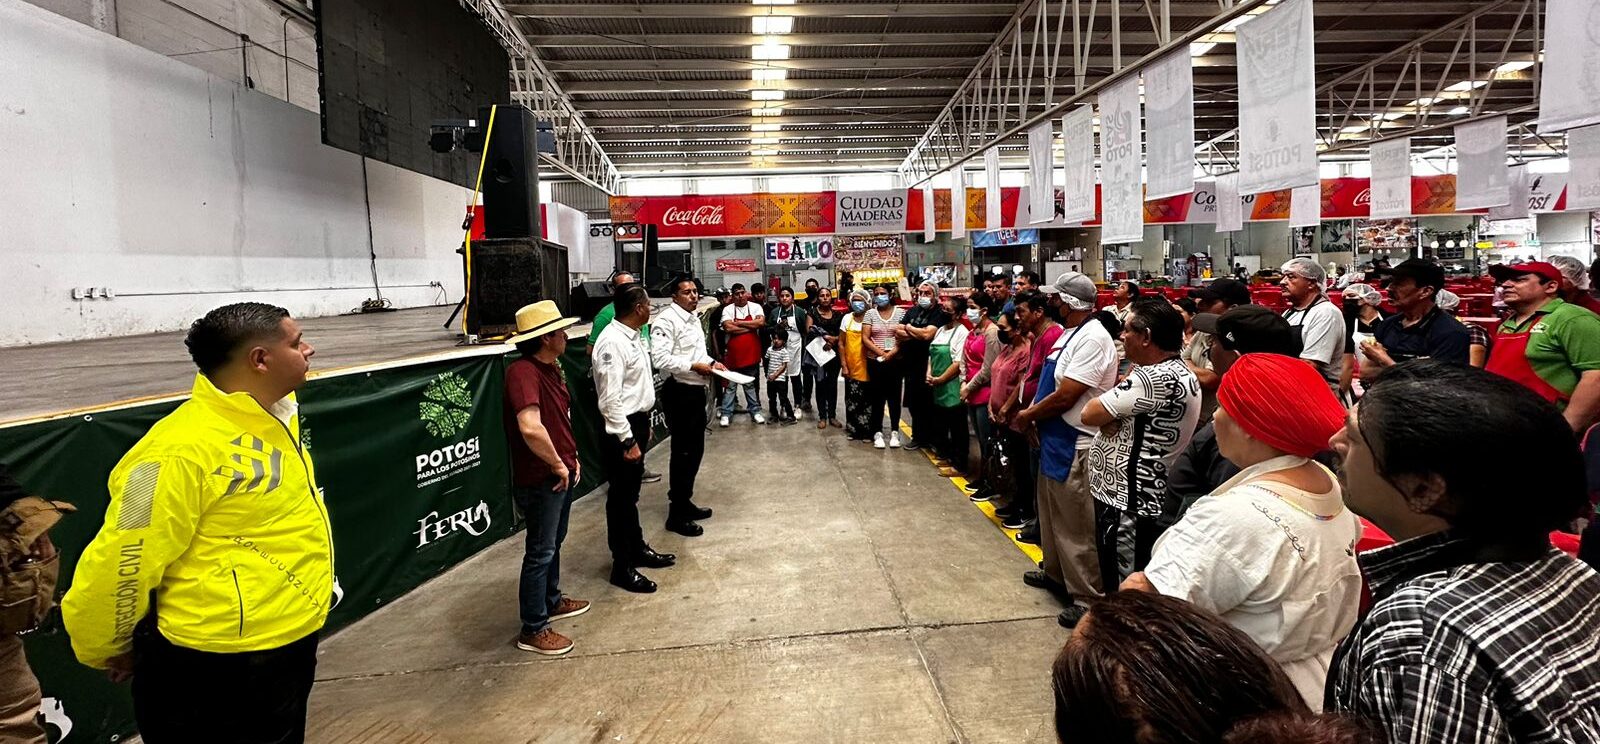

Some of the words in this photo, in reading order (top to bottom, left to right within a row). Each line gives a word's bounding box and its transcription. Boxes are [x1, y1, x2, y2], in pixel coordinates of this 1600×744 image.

[840, 196, 904, 210] CIUDAD
[663, 205, 725, 226] Coca-Cola
[840, 209, 903, 221] MADERAS
[854, 239, 897, 248] BIENVENIDOS
[417, 469, 436, 481] PARA
[436, 464, 450, 474] LOS
[450, 452, 480, 469] POTOSINOS
[118, 539, 144, 577] CIVIL
